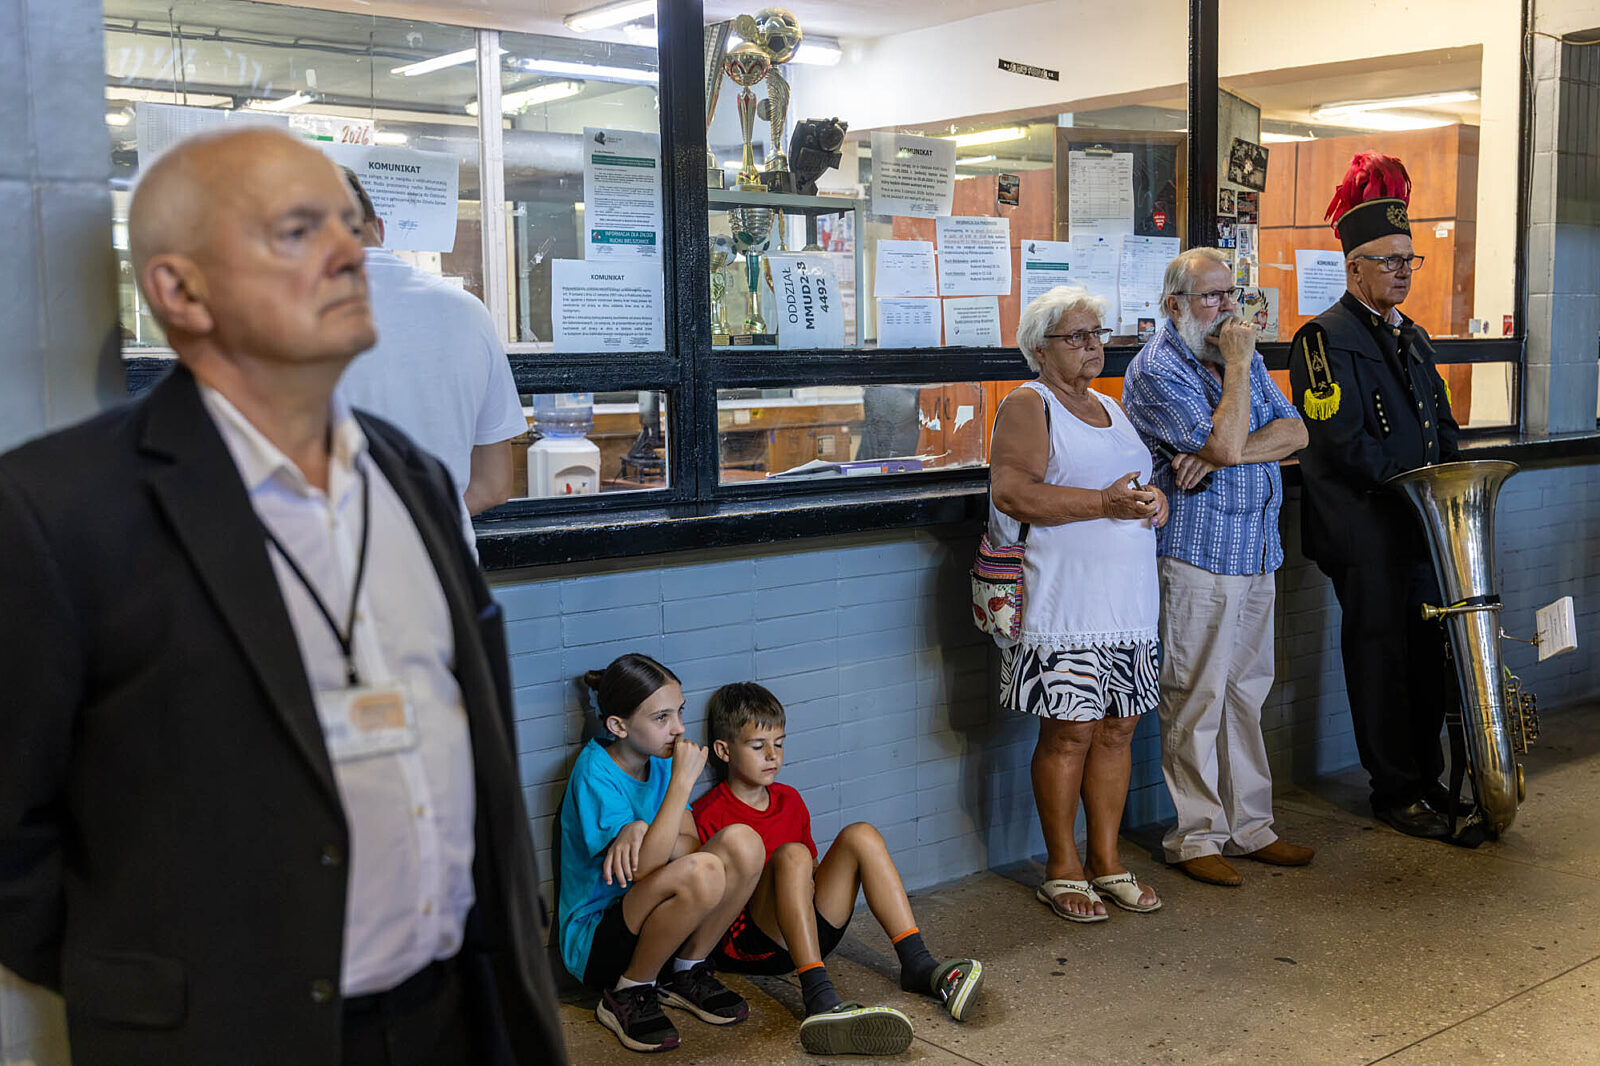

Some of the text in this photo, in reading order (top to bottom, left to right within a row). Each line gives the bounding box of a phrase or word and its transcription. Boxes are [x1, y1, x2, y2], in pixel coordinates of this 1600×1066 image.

[341, 125, 369, 145] 2026
[368, 161, 421, 174] KOMUNIKAT
[782, 267, 798, 324] ODDZIAŁ
[816, 278, 830, 313] 4492
